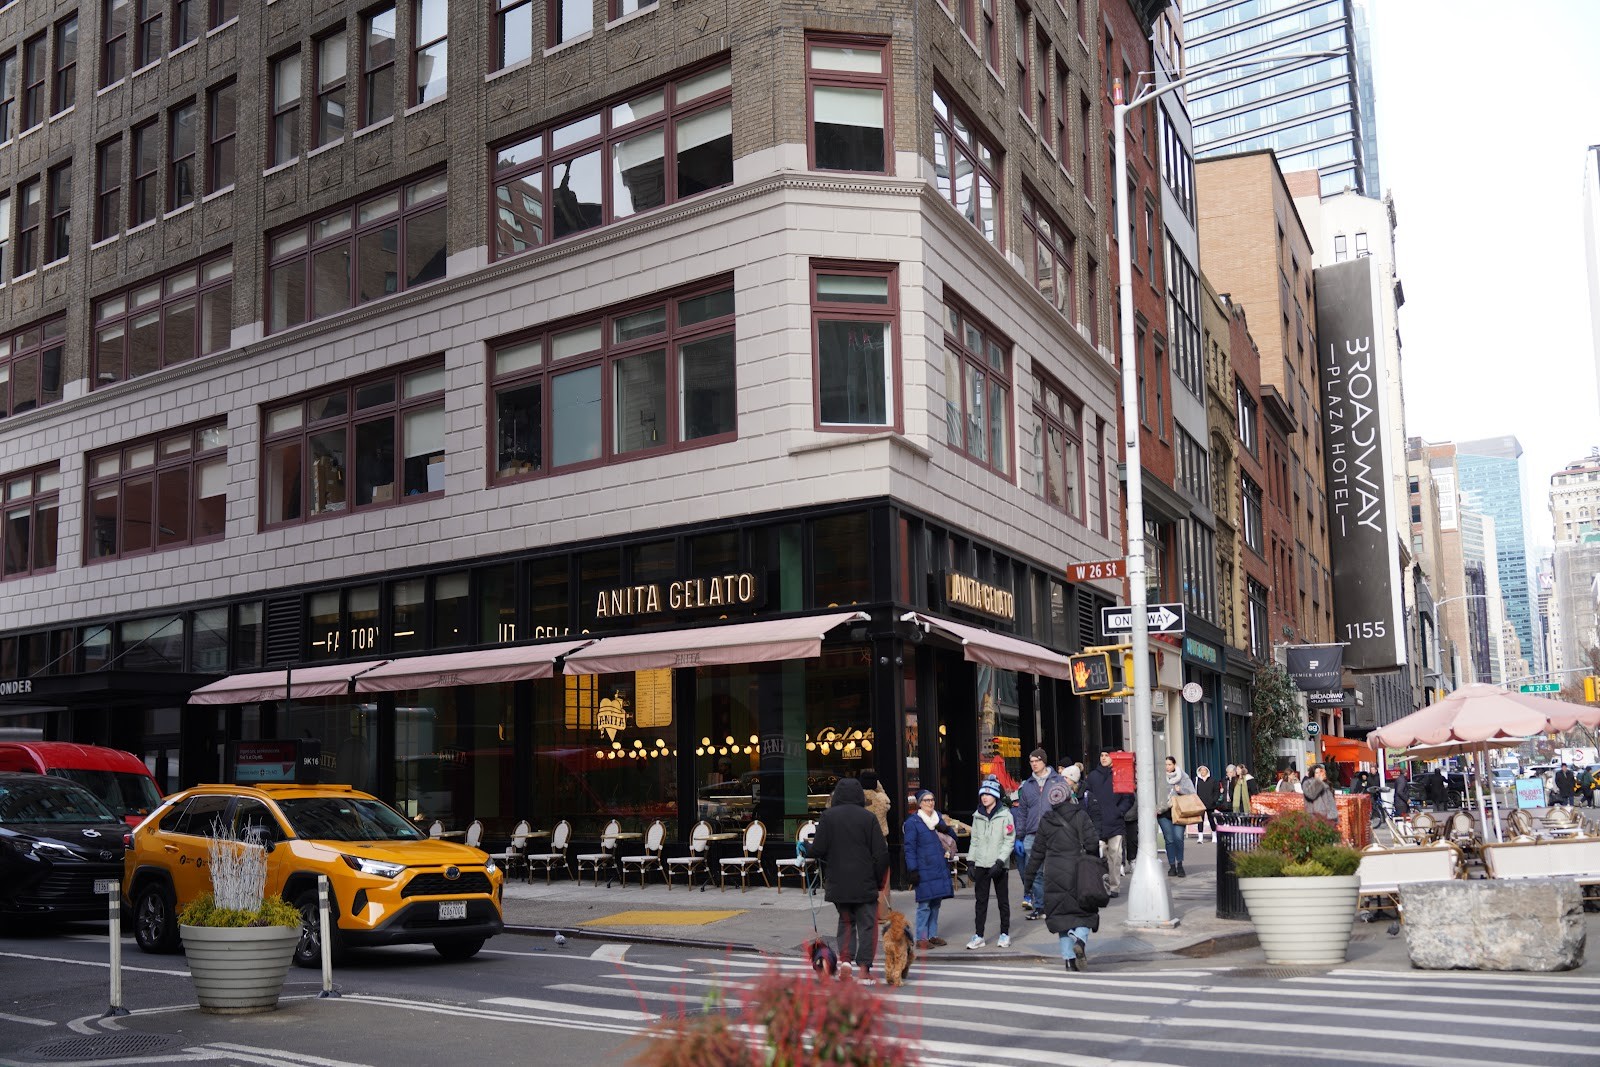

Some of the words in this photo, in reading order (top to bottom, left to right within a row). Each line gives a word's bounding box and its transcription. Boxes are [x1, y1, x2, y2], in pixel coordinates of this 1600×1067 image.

[1327, 366, 1344, 435] PLAZA
[1346, 336, 1382, 533] BROADWAY
[1331, 442, 1349, 515] HOTEL
[1076, 566, 1086, 579] W
[1089, 564, 1102, 578] 26
[1105, 562, 1117, 577] St
[596, 583, 660, 617] ANITA
[669, 573, 753, 609] GELATO
[952, 574, 982, 608] ANITA
[982, 585, 1014, 618] GELATO
[1114, 616, 1132, 627] ON
[1147, 613, 1171, 624] WAY
[1345, 621, 1385, 639] 1155
[327, 626, 380, 653] FATOR
[0, 680, 32, 695] ONDER
[599, 715, 625, 726] ANITA
[303, 757, 319, 766] 9K16
